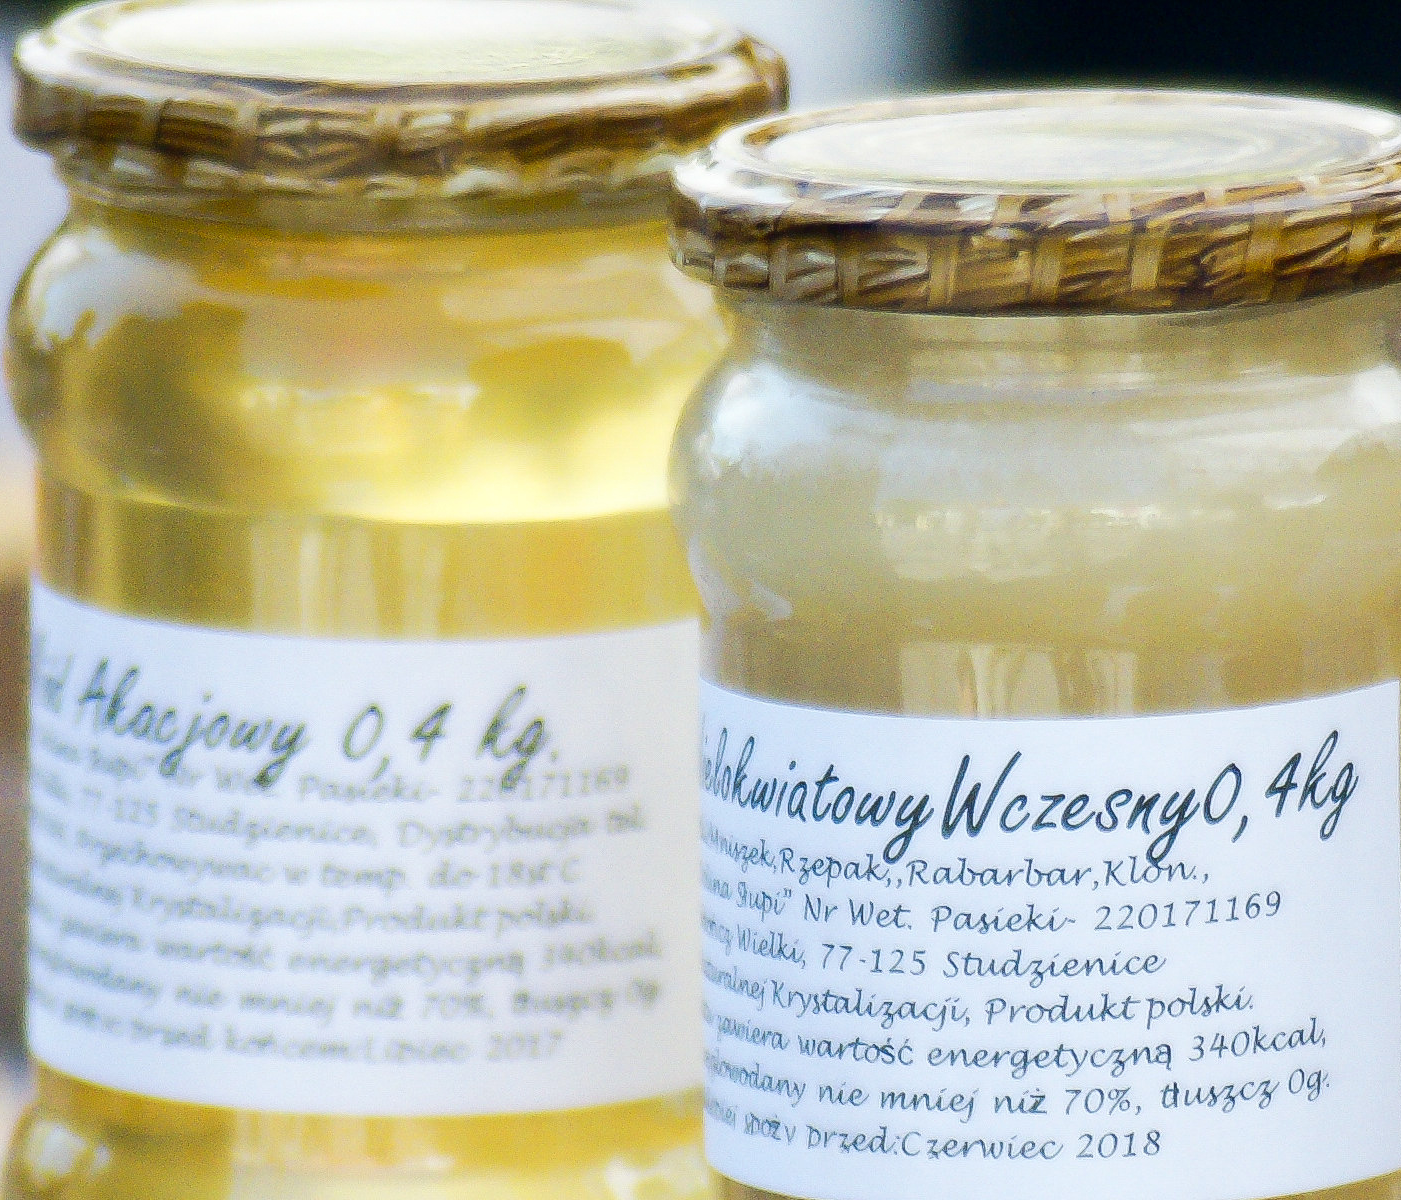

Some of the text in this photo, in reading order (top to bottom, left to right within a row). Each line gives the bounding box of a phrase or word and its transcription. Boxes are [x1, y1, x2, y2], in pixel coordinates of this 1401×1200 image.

[76, 656, 309, 788] Akacjowy
[804, 893, 839, 924] Nr
[848, 898, 912, 930] Wet.
[1094, 890, 1281, 931] 220171169
[737, 923, 806, 970] Wielki,
[821, 942, 926, 976] 77-125
[942, 948, 1167, 988] Studzienice
[771, 979, 970, 1032] Krystalizacji,
[985, 992, 1141, 1025] Produkt
[1146, 983, 1254, 1030] polski.
[717, 1013, 1326, 1080] zawiera wartość energetyczną 340kcal,
[818, 1081, 870, 1107] nie
[880, 1087, 980, 1124] mniej
[994, 1087, 1048, 1115] niż
[1064, 1086, 1142, 1117] 70%,
[1160, 1079, 1280, 1114] tłuszcz
[1288, 1067, 1330, 1103] 0g.
[1076, 1129, 1161, 1160] 2018
